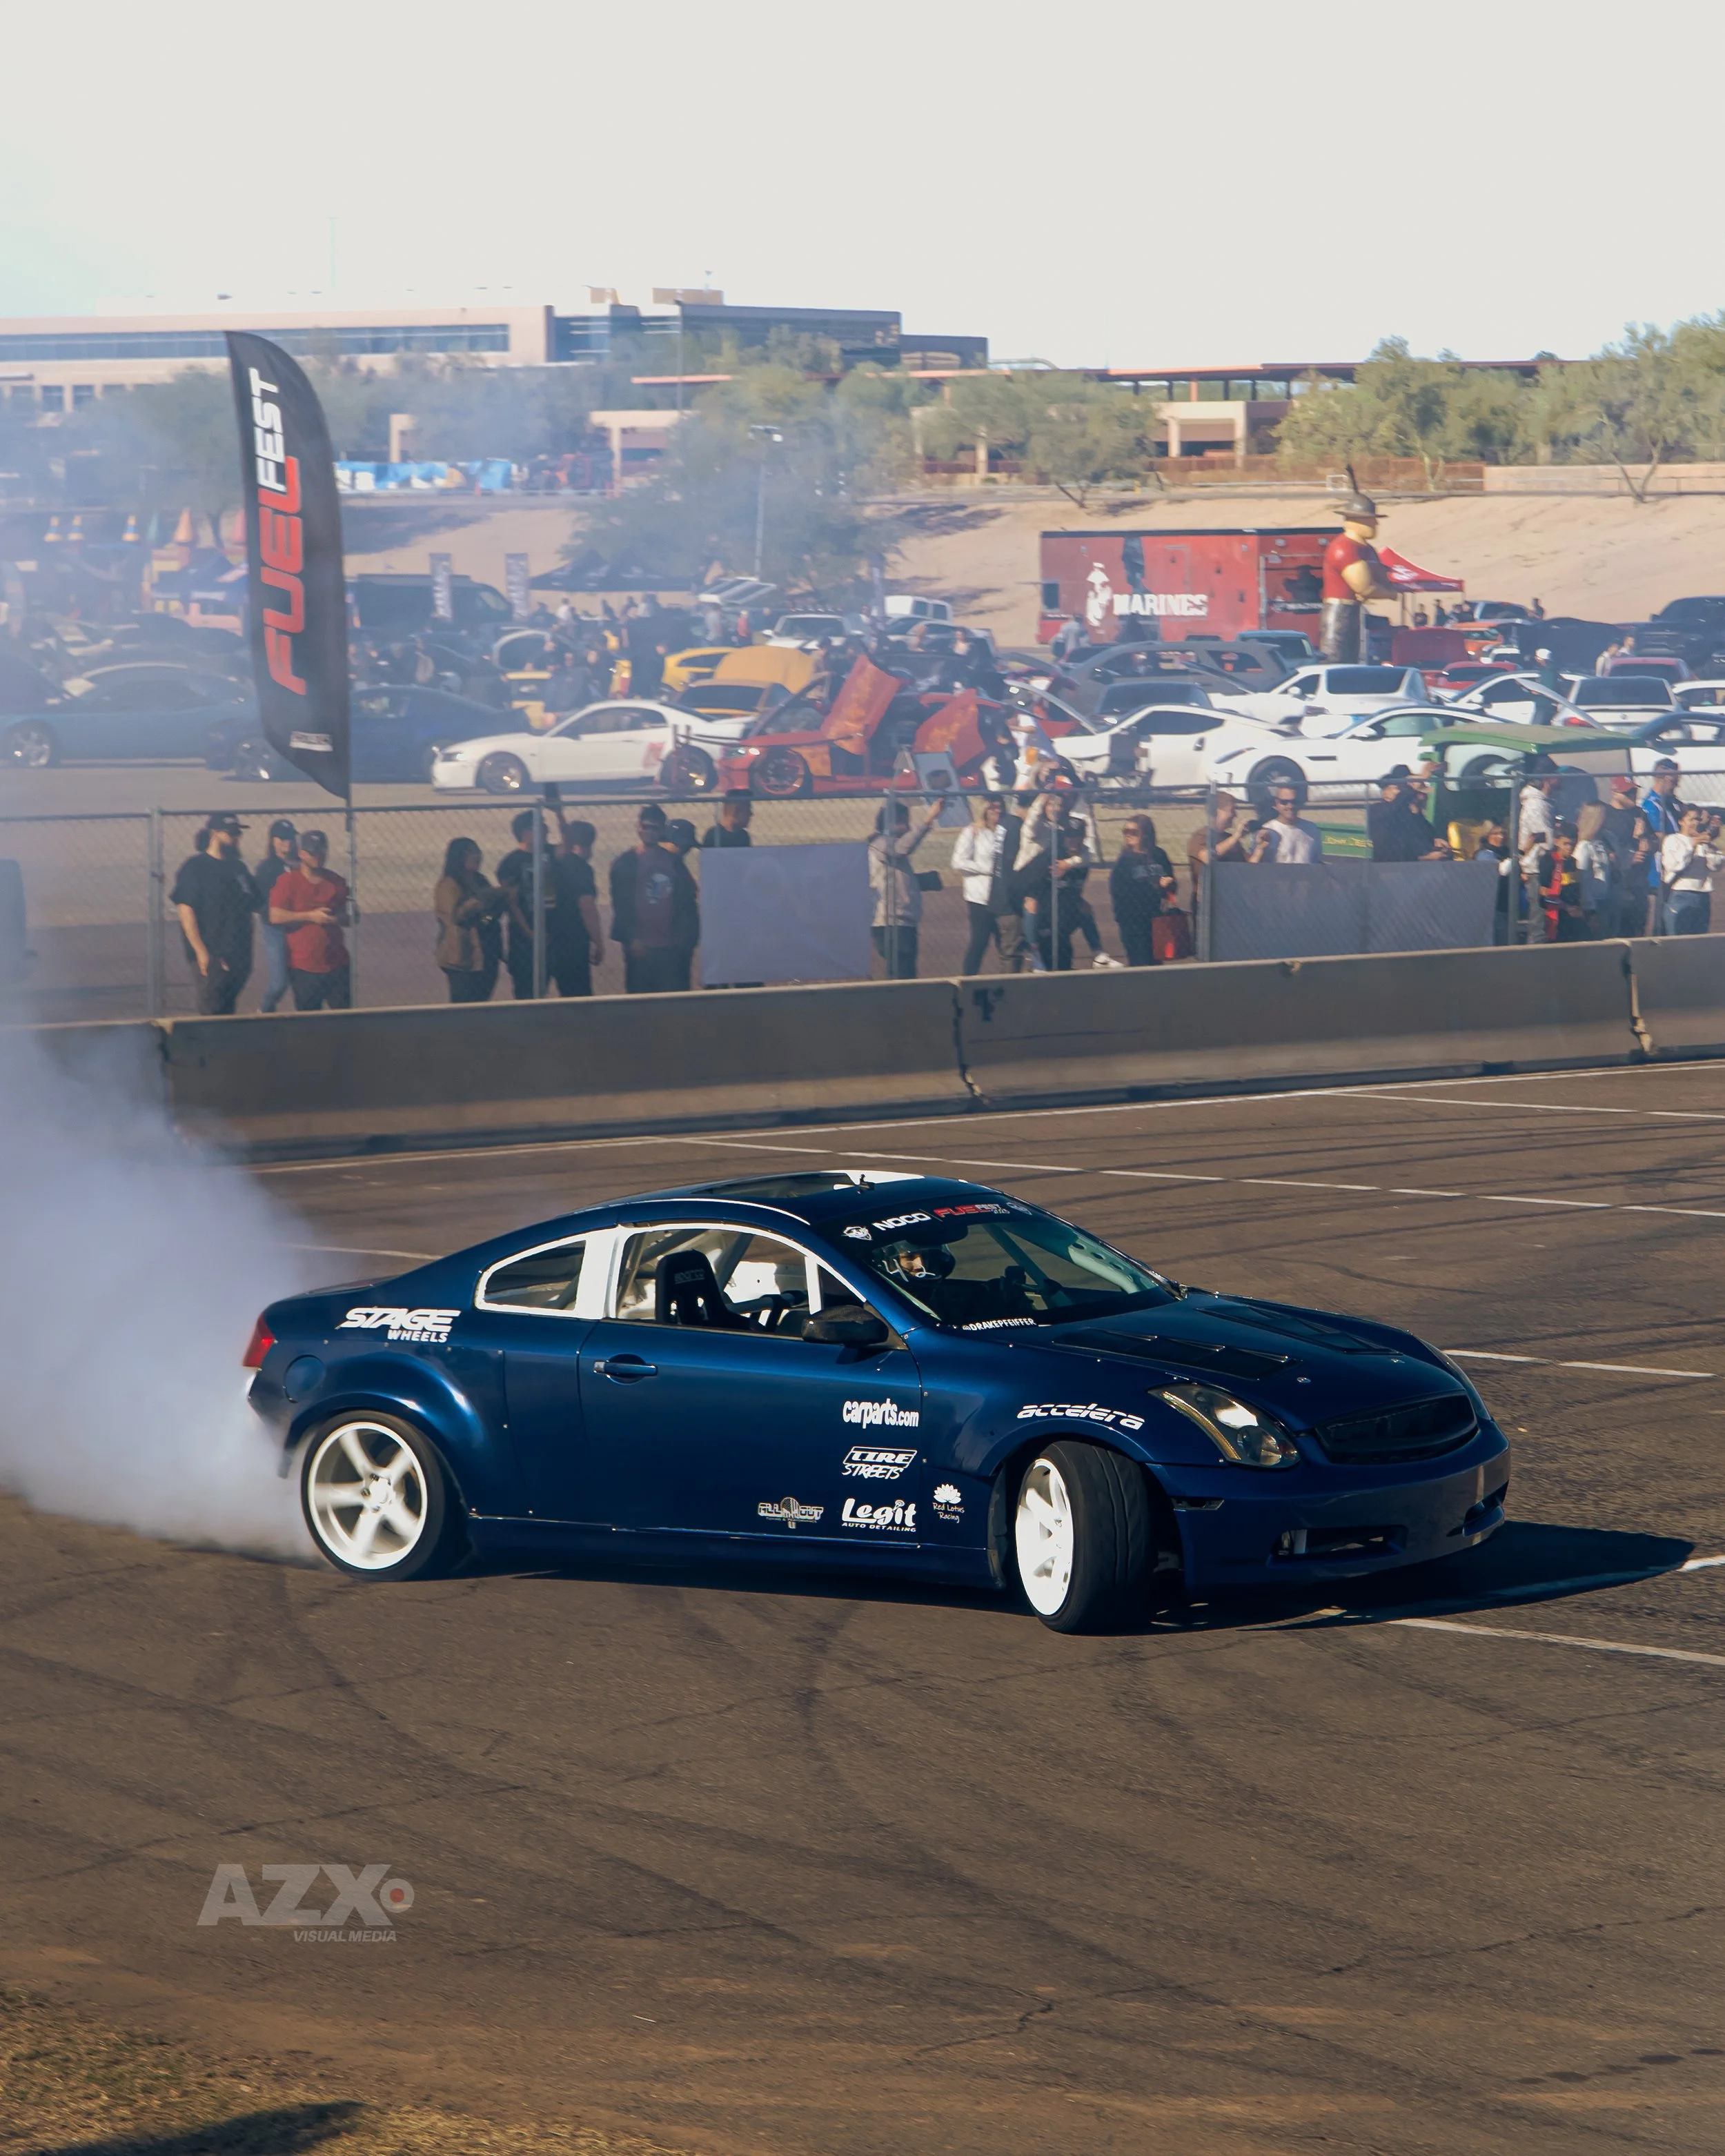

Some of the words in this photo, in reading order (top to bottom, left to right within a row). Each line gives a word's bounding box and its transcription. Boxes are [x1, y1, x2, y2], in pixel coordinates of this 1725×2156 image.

[1112, 593, 1208, 616] MARINES
[871, 1213, 931, 1231] NOCO
[335, 1307, 461, 1332] STAGE
[962, 1317, 1037, 1331] @DRAKEPFEIFFER
[387, 1329, 448, 1343] WHEELS
[842, 1398, 919, 1429] carparts.com
[1016, 1403, 1145, 1430] accelera
[851, 1451, 913, 1464] TIRE
[842, 1463, 904, 1480] STREETS
[842, 1498, 917, 1527] Legit
[932, 1502, 945, 1511] Red
[947, 1503, 965, 1513] Lotus
[937, 1512, 960, 1523] Racing
[869, 1523, 917, 1533] DETAILING
